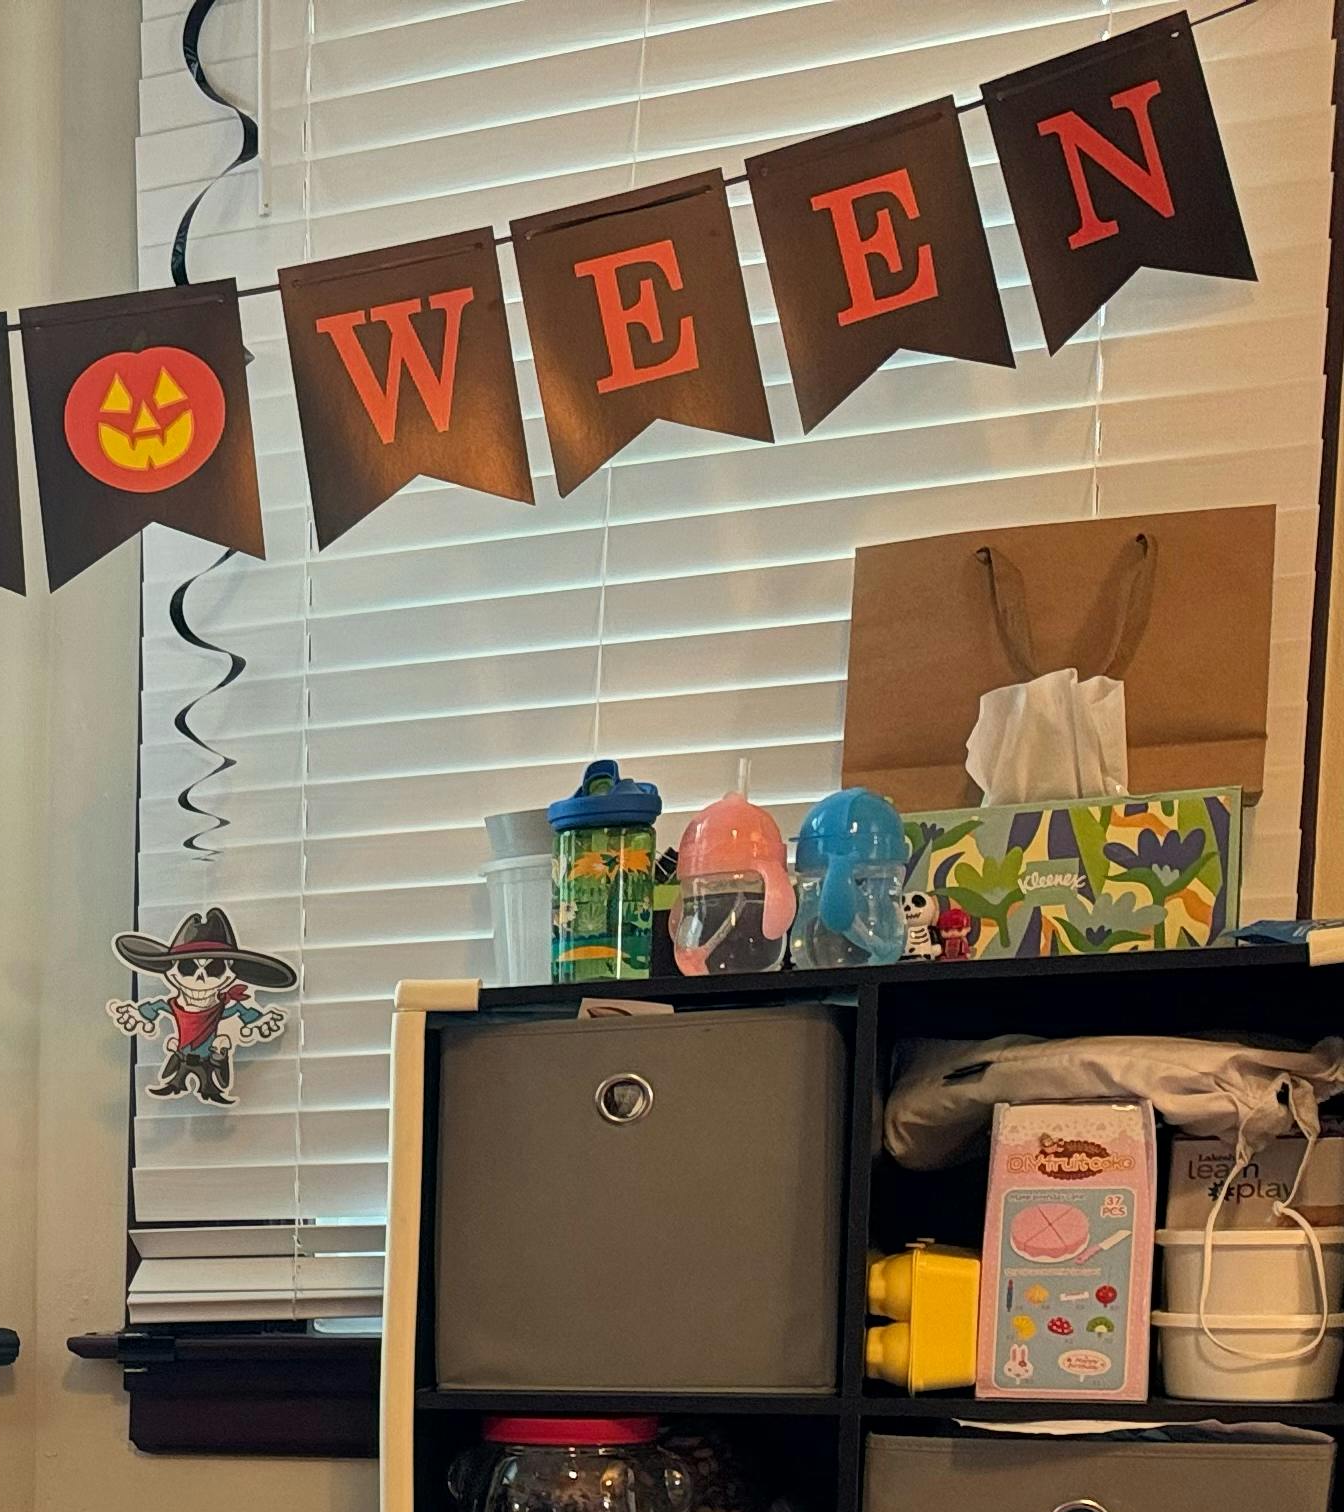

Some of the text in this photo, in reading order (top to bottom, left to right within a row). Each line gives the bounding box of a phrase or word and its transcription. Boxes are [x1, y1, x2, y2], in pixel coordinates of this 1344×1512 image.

[1018, 871, 1087, 895] Kleenex
[1188, 1159, 1260, 1180] lean
[1105, 1195, 1124, 1207] 37
[1101, 1206, 1128, 1218] PCS
